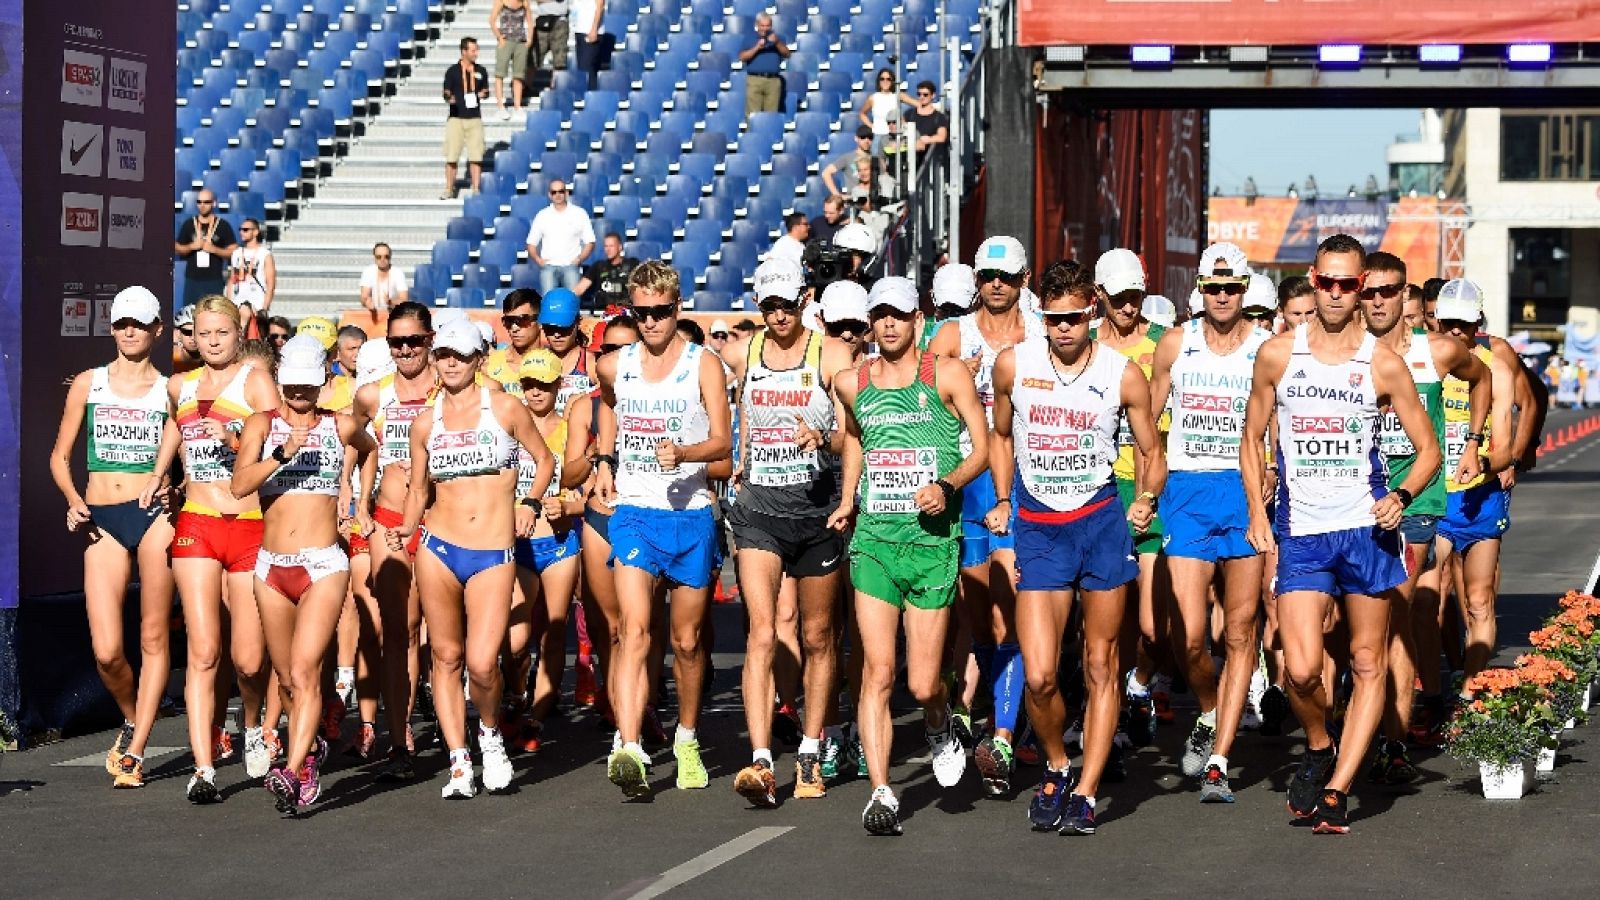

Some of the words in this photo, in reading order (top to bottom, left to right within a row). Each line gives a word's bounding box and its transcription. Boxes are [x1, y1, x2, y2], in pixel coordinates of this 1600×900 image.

[1317, 214, 1379, 228] EUROPEAN
[751, 389, 813, 407] GERMANY
[1182, 393, 1231, 411] SPAR
[1287, 385, 1364, 406] SLOVAKIA
[620, 397, 688, 414] FINLAND
[96, 408, 144, 421] SPAR
[1029, 404, 1099, 431] NORWAY
[624, 416, 665, 432] SPAR
[1292, 416, 1344, 433] SPAR
[432, 431, 476, 450] SPAR
[1028, 434, 1078, 450] SPAR
[1293, 436, 1349, 455] TÓTH
[869, 451, 915, 465] SPAR
[1029, 453, 1087, 472] HAUKENES
[1296, 468, 1331, 478] BERLIN
